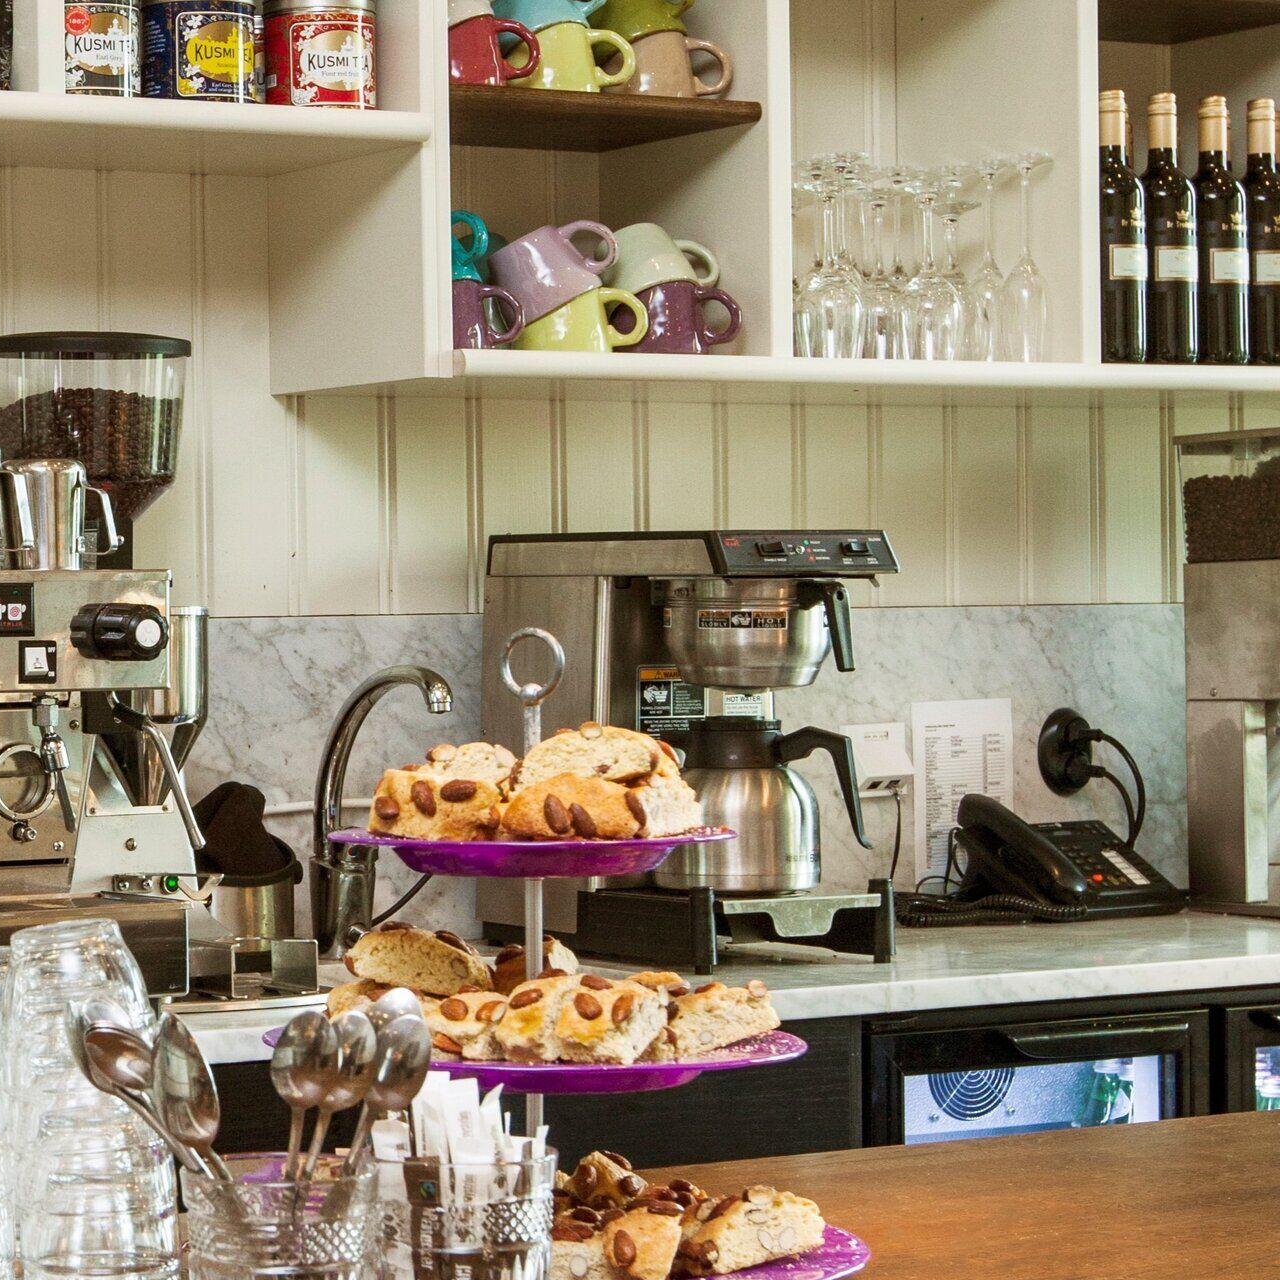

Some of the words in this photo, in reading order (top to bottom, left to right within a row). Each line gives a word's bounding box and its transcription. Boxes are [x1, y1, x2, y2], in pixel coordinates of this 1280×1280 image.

[74, 36, 115, 54] KUSMI
[195, 44, 235, 61] KUSMI
[308, 53, 348, 71] KUSMI
[353, 56, 369, 71] TA
